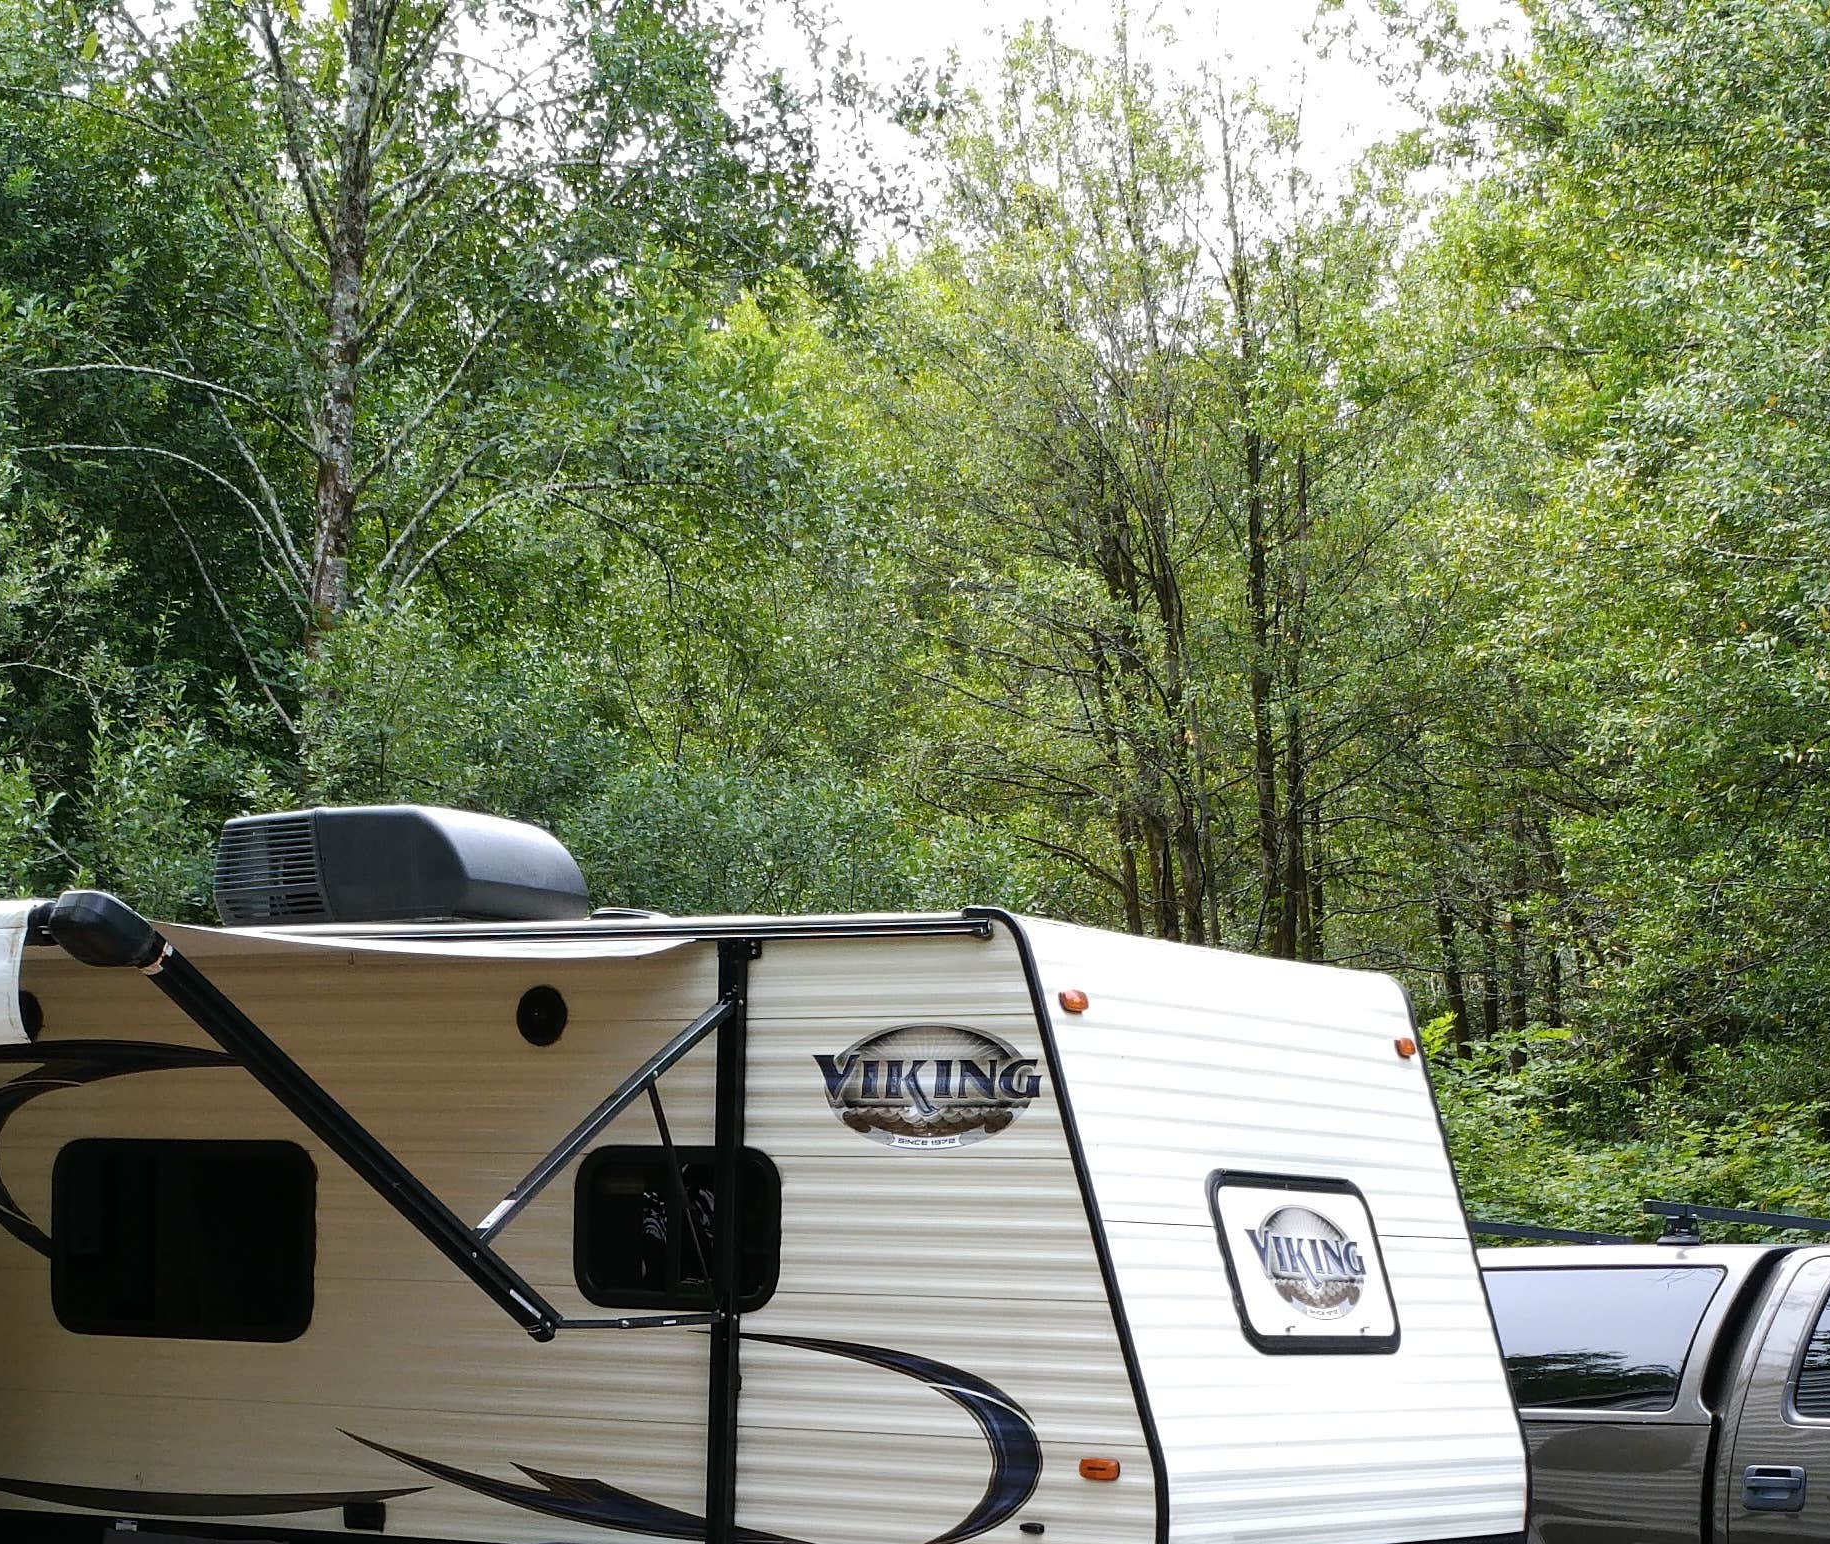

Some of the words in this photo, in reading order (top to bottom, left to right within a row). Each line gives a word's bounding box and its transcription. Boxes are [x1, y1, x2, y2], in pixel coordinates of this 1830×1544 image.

[814, 1054, 1042, 1117] VIKING
[898, 1137, 928, 1146] SINCE
[1244, 1228, 1367, 1290] VIKING
